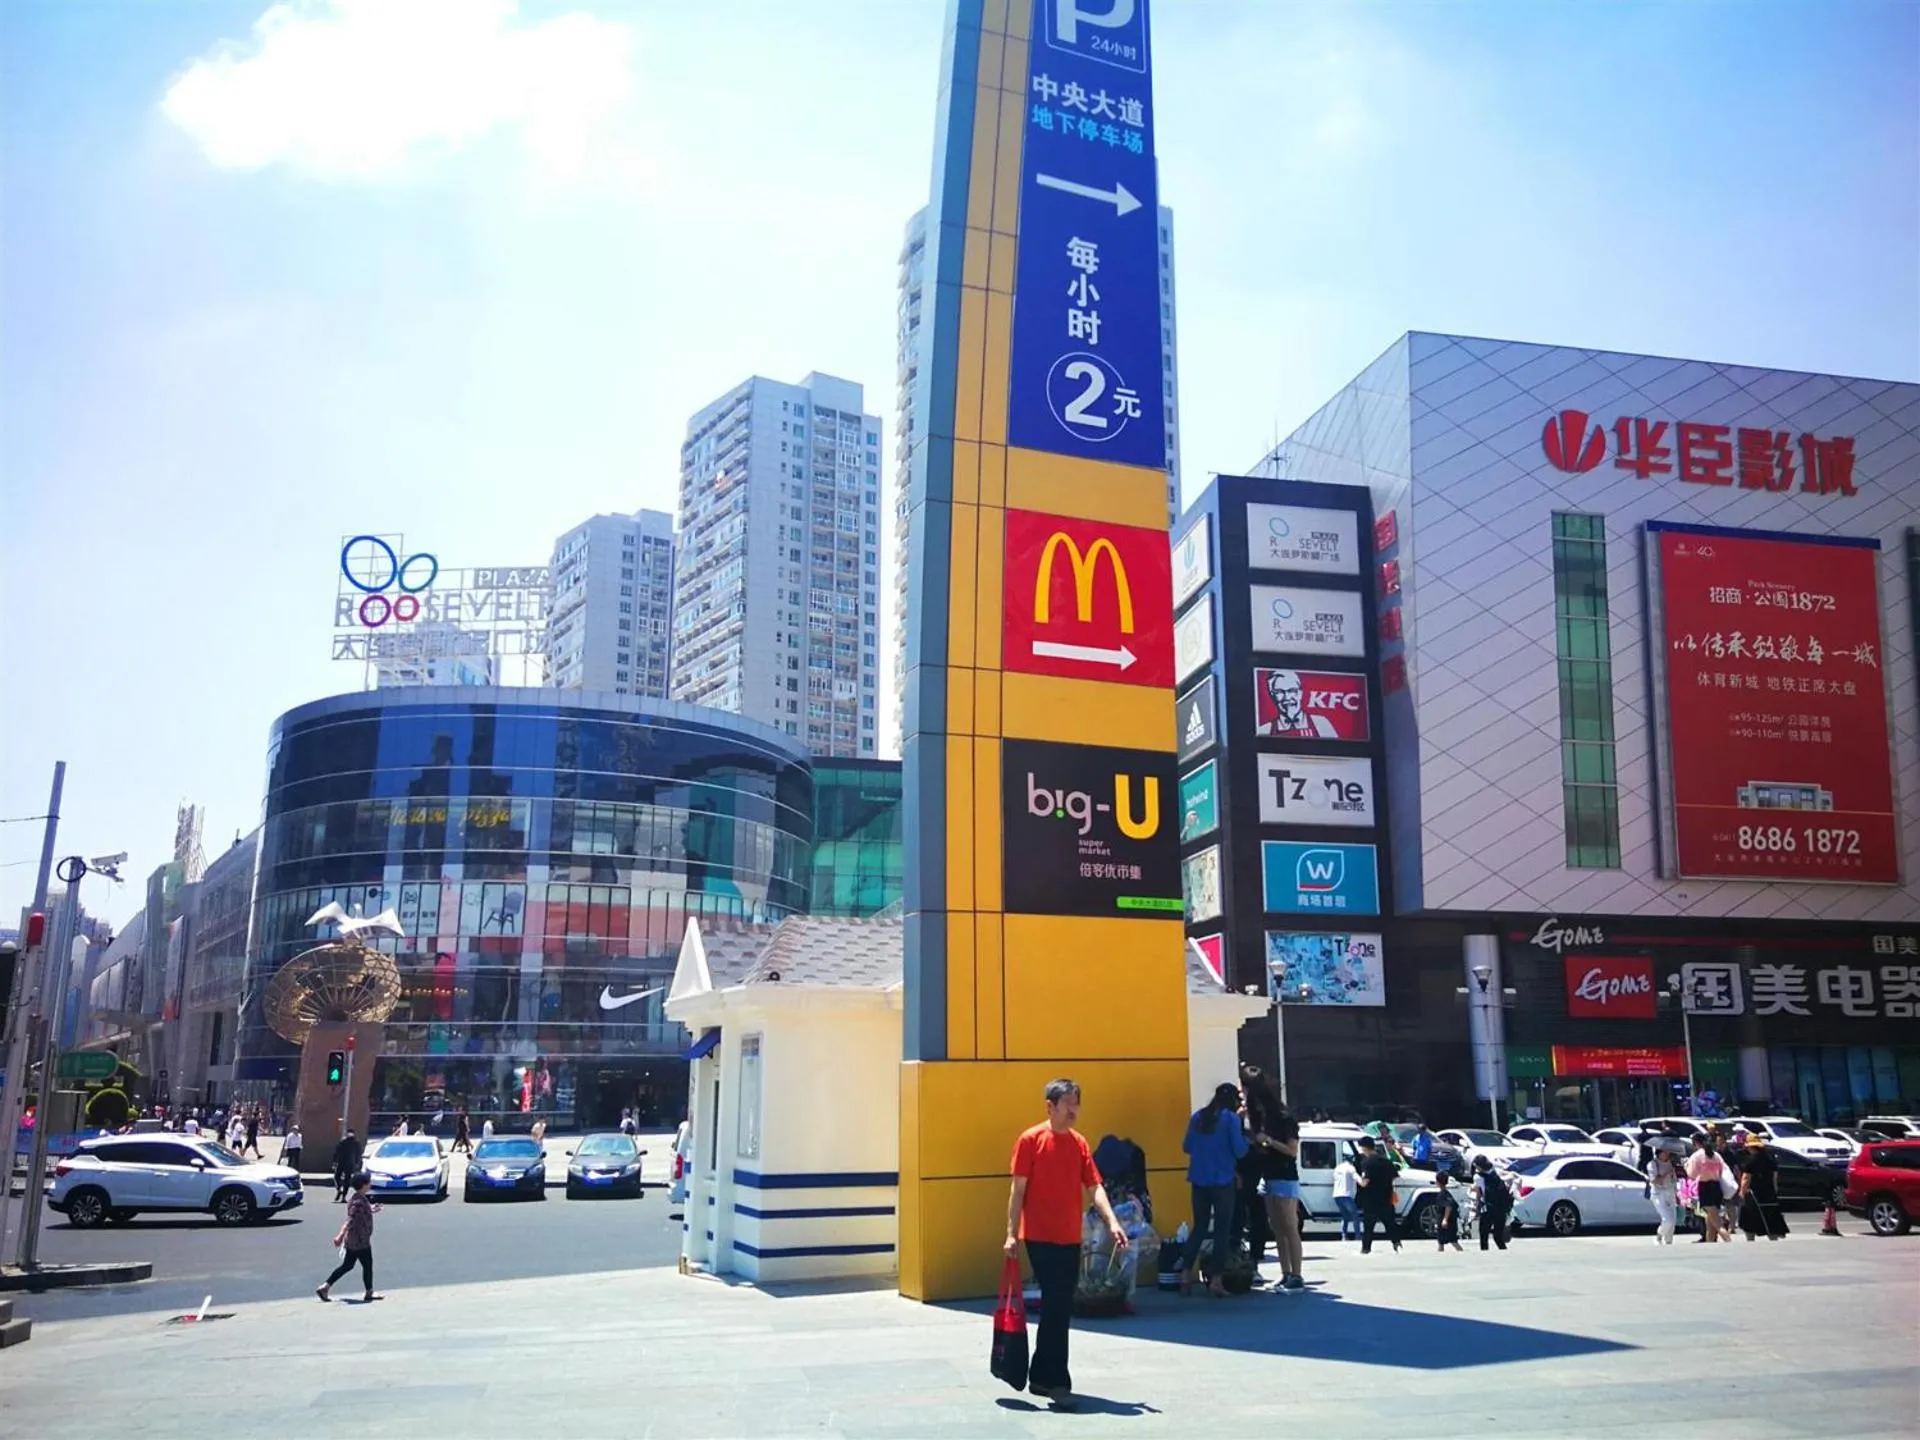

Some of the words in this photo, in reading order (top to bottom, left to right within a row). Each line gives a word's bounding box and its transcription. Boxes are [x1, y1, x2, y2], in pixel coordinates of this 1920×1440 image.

[1091, 35, 1137, 61] 24小时
[1032, 72, 1144, 128] 中央大道
[1031, 104, 1143, 154] 地下停车场
[1066, 236, 1101, 345] 每小时
[1612, 416, 1858, 496] 华臣影城
[1308, 690, 1360, 711] KFC
[1738, 826, 1796, 850] 8686
[1804, 828, 1861, 854] 1872
[1681, 961, 1920, 1019] 国美电器
